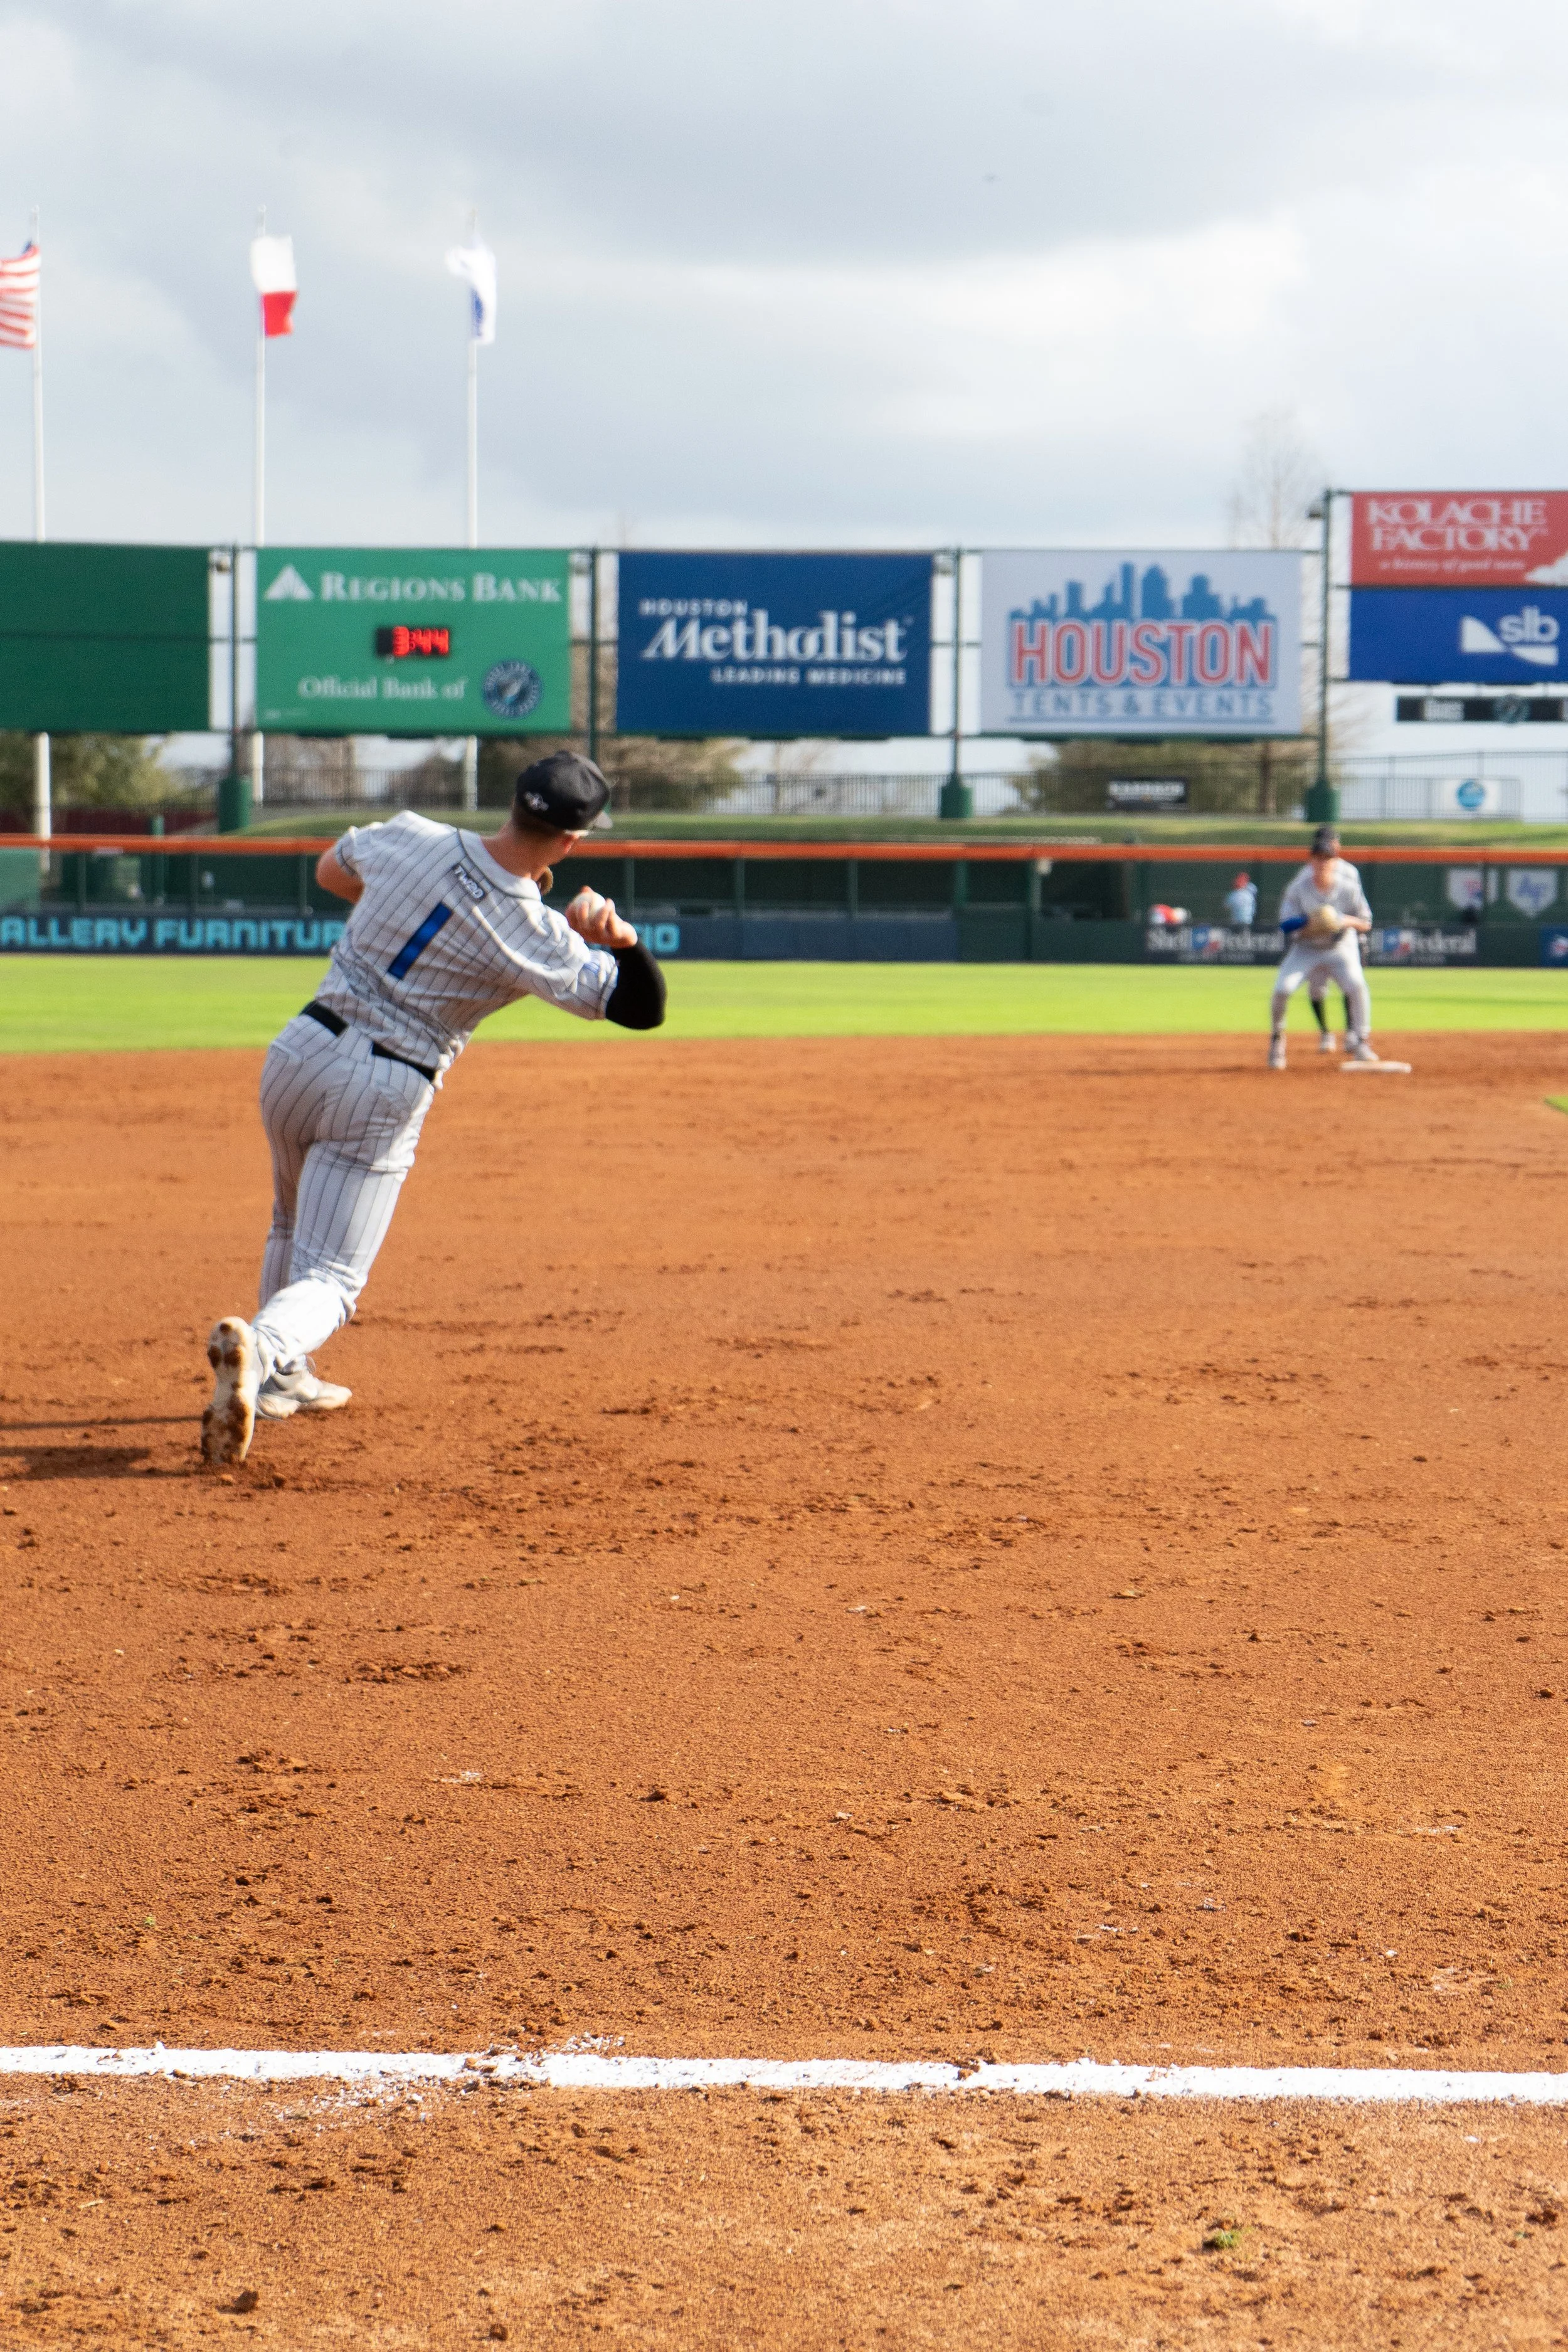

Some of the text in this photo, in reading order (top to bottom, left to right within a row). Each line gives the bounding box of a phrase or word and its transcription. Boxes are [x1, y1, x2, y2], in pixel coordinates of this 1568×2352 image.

[1367, 500, 1547, 525] KOLACHE
[1372, 526, 1539, 551] FACTORY
[320, 572, 561, 603] REGIONS BANK
[638, 598, 748, 617] HOUSTON
[641, 608, 908, 663] Methodist
[1498, 607, 1560, 644] slb
[1010, 618, 1277, 688] HOUSTON
[298, 675, 468, 699] Official Bank of
[710, 666, 908, 686] LEADING MEDICINE
[1012, 692, 1274, 716] TENTS & EVENTS
[0, 916, 147, 949] ALLERY
[155, 918, 347, 950] FURNITUR
